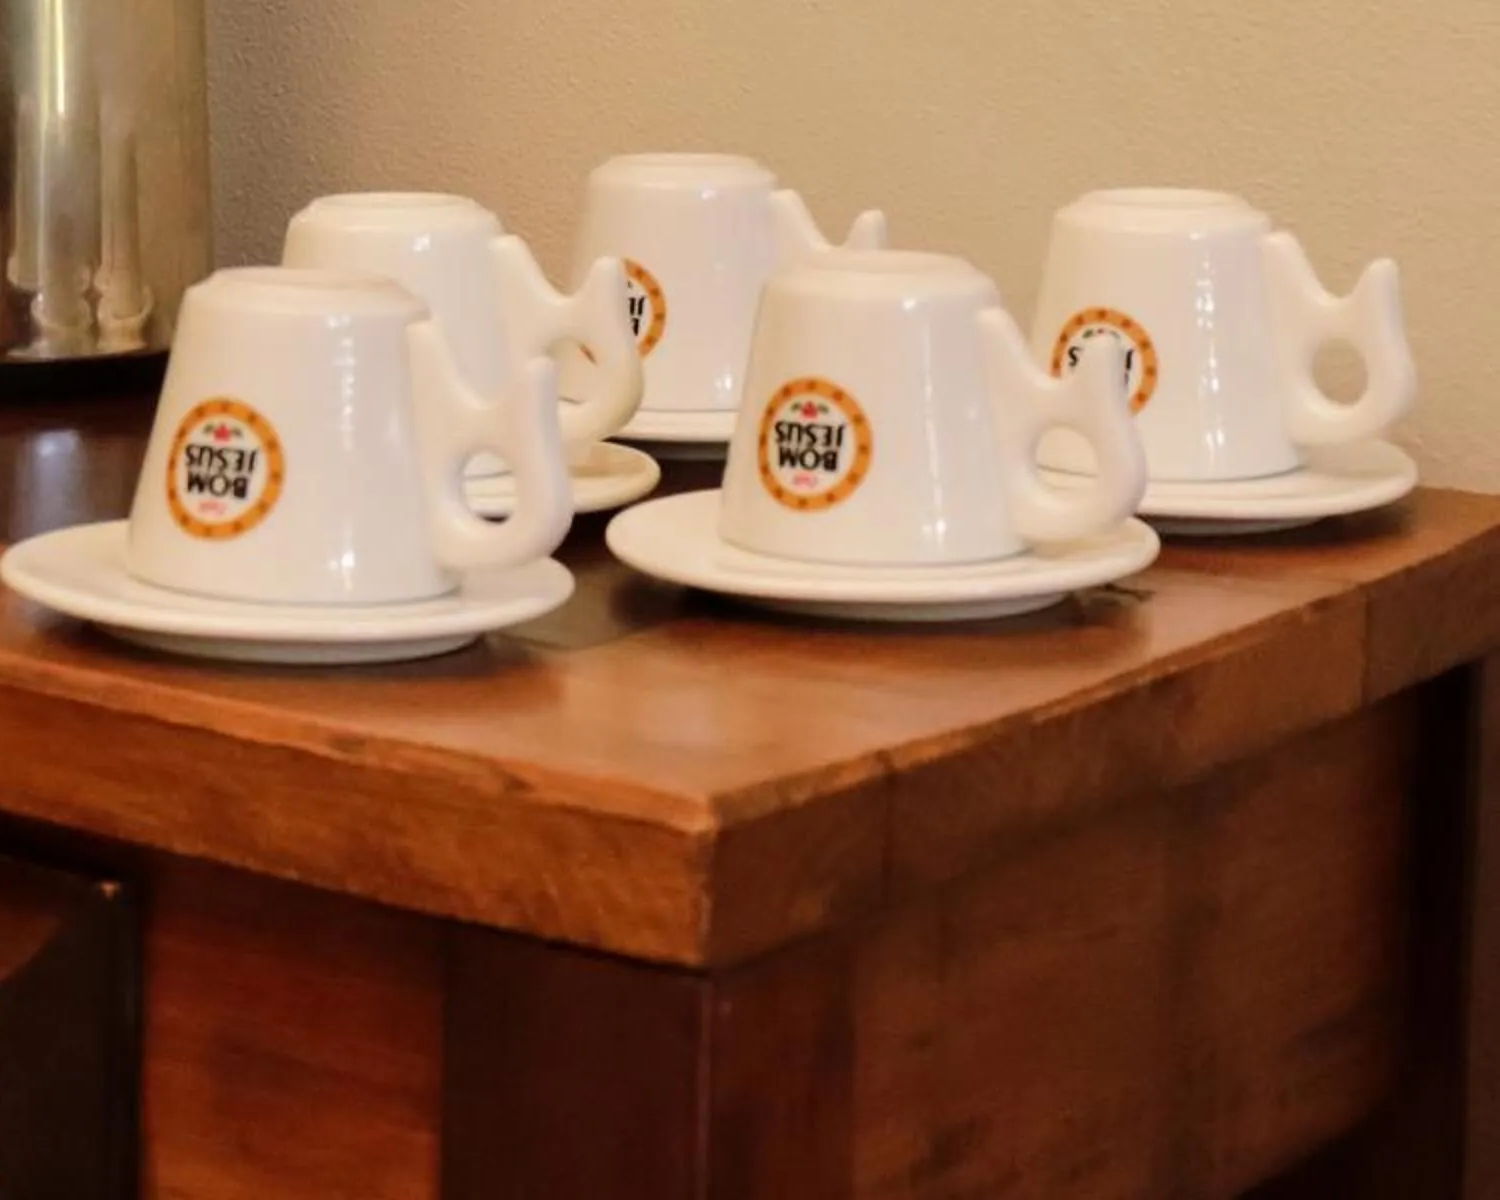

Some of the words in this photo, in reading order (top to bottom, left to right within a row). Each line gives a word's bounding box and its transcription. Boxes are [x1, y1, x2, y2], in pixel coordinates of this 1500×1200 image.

[774, 420, 845, 449] JESUS
[185, 444, 259, 473] JESUS
[778, 447, 838, 472] BOM
[187, 473, 248, 499] BOM
